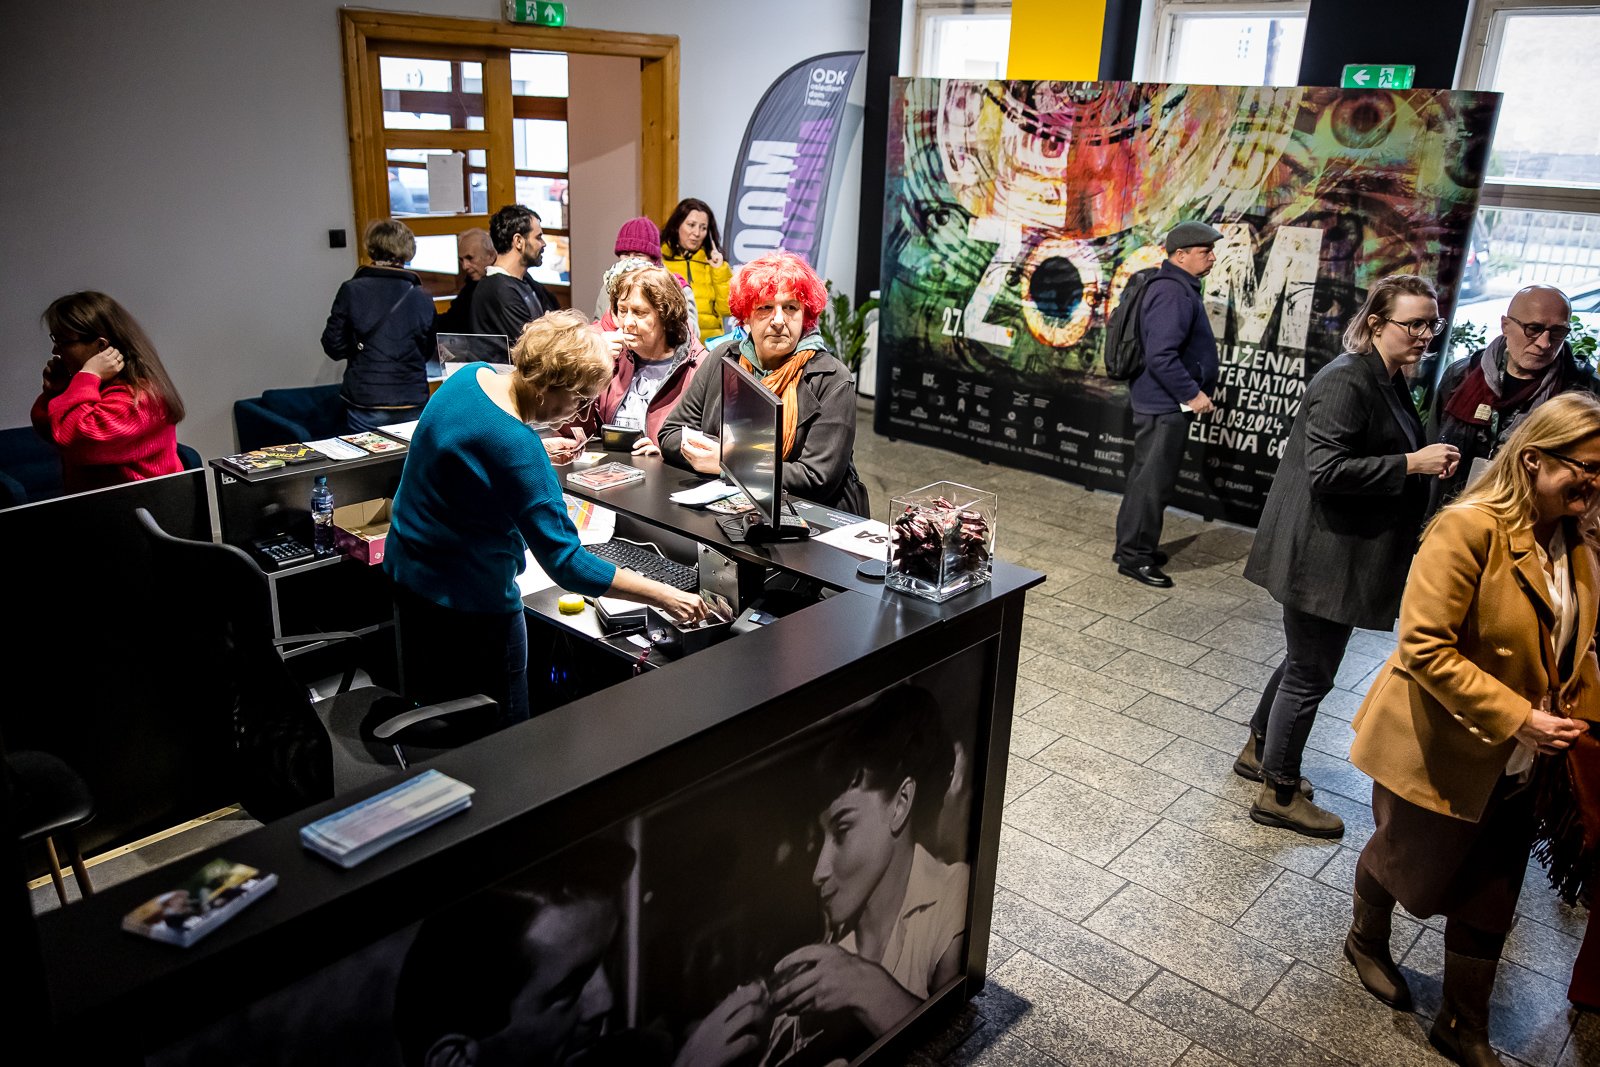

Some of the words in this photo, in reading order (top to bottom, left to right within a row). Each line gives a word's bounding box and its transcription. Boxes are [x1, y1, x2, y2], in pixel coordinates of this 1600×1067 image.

[812, 67, 848, 85] ODK
[732, 140, 801, 270] OOM
[942, 306, 964, 338] 27.
[1216, 344, 1305, 378] LIŻENIA
[1217, 366, 1307, 397] TERNATION
[1188, 421, 1258, 454] ELENIA
[1267, 436, 1289, 460] GÓ
[854, 530, 889, 545] SA
